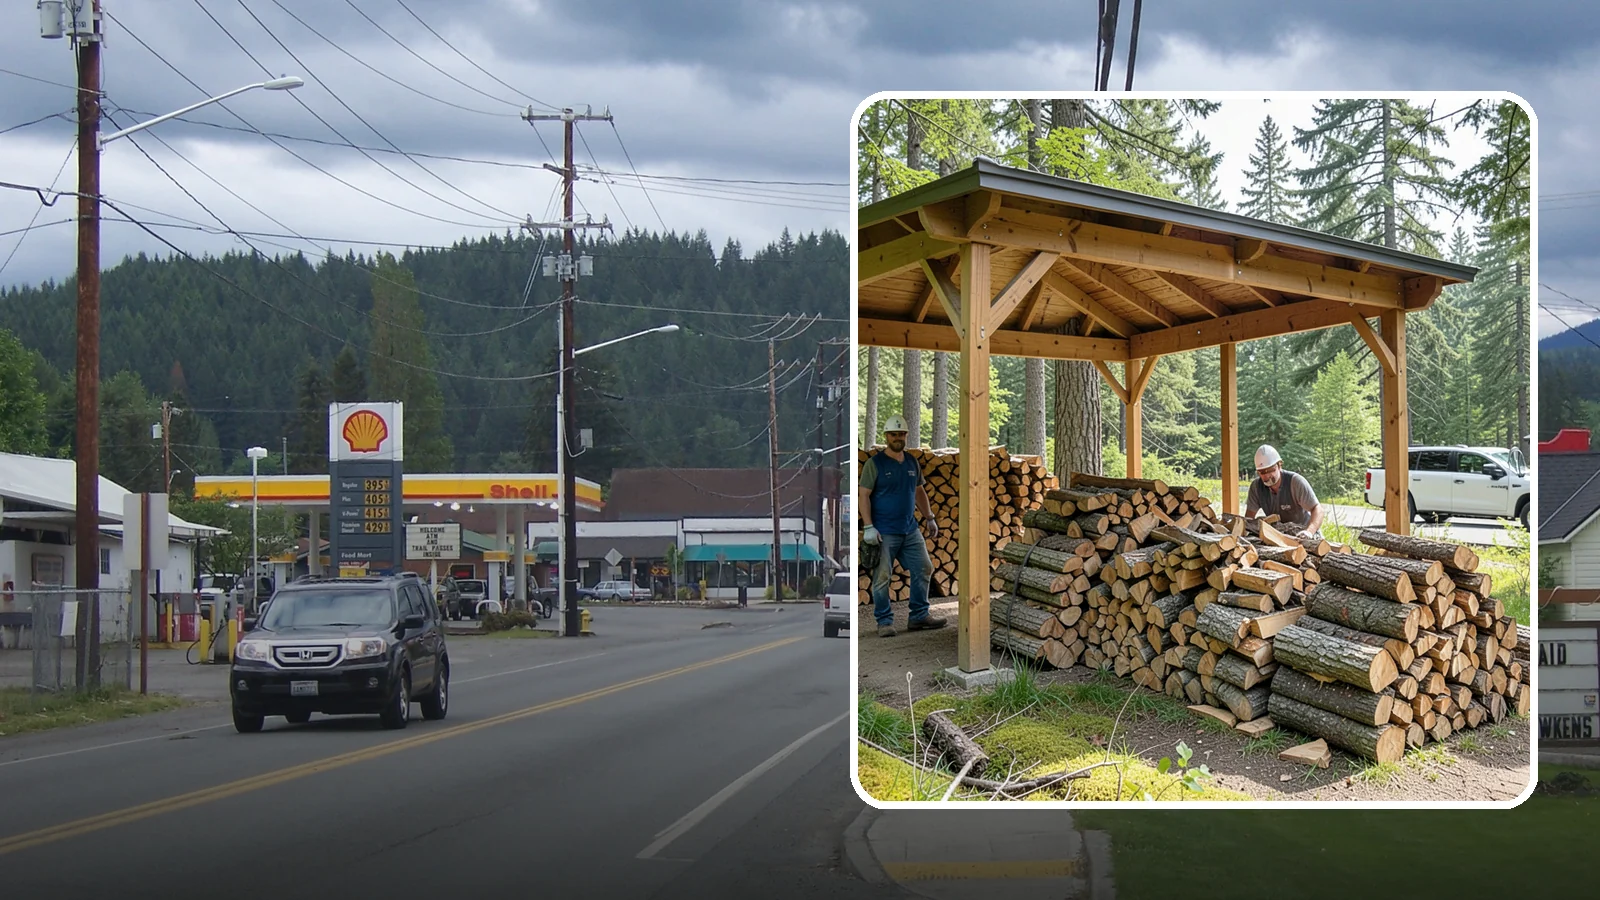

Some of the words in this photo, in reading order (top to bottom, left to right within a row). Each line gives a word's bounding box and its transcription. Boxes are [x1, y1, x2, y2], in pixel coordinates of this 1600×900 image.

[366, 480, 383, 490] 395
[490, 484, 547, 499] Shell
[366, 494, 384, 504] 405
[366, 508, 383, 518] 415
[366, 522, 383, 532] 429
[1538, 643, 1567, 665] AID
